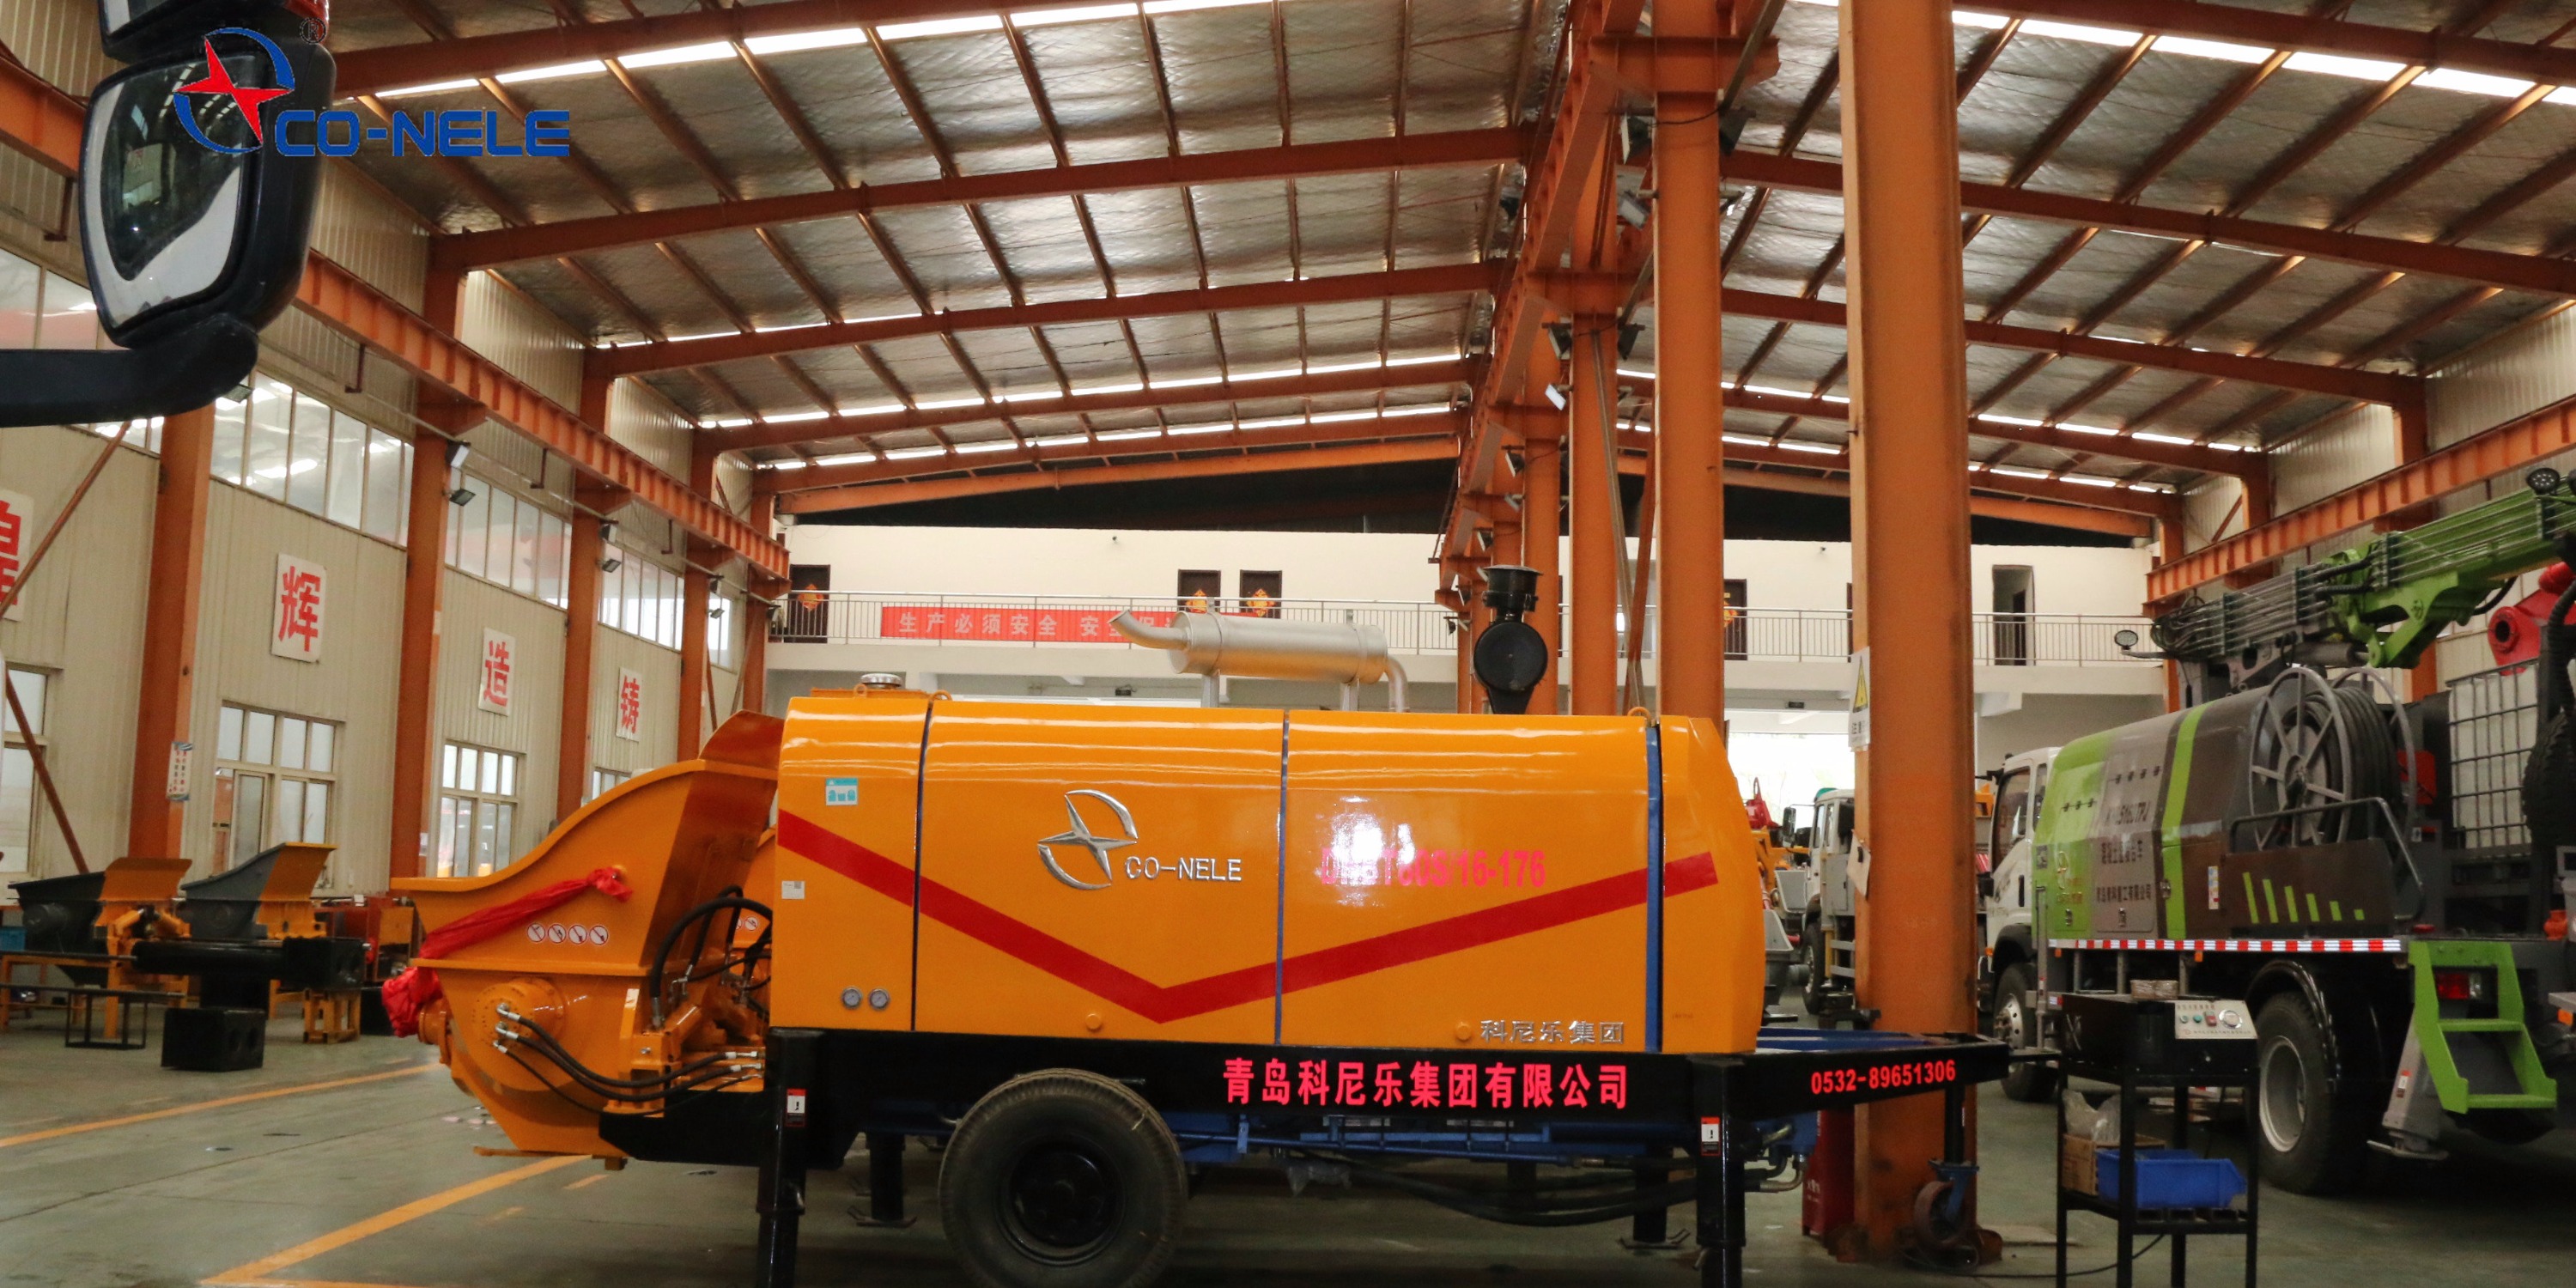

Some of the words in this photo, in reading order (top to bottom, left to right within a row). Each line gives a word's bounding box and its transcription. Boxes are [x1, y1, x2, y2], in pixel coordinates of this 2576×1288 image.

[277, 565, 321, 653] 辉
[899, 612, 1057, 635] 生产必须安全
[483, 640, 510, 708] 造
[620, 675, 641, 734] 铸
[1125, 855, 1242, 882] CO-NELE
[1479, 1019, 1625, 1045] 科尼乐集团
[1223, 1057, 1628, 1110] 青岛科尼乐集团有限公司
[1811, 1059, 1957, 1095] 0532-89651306
